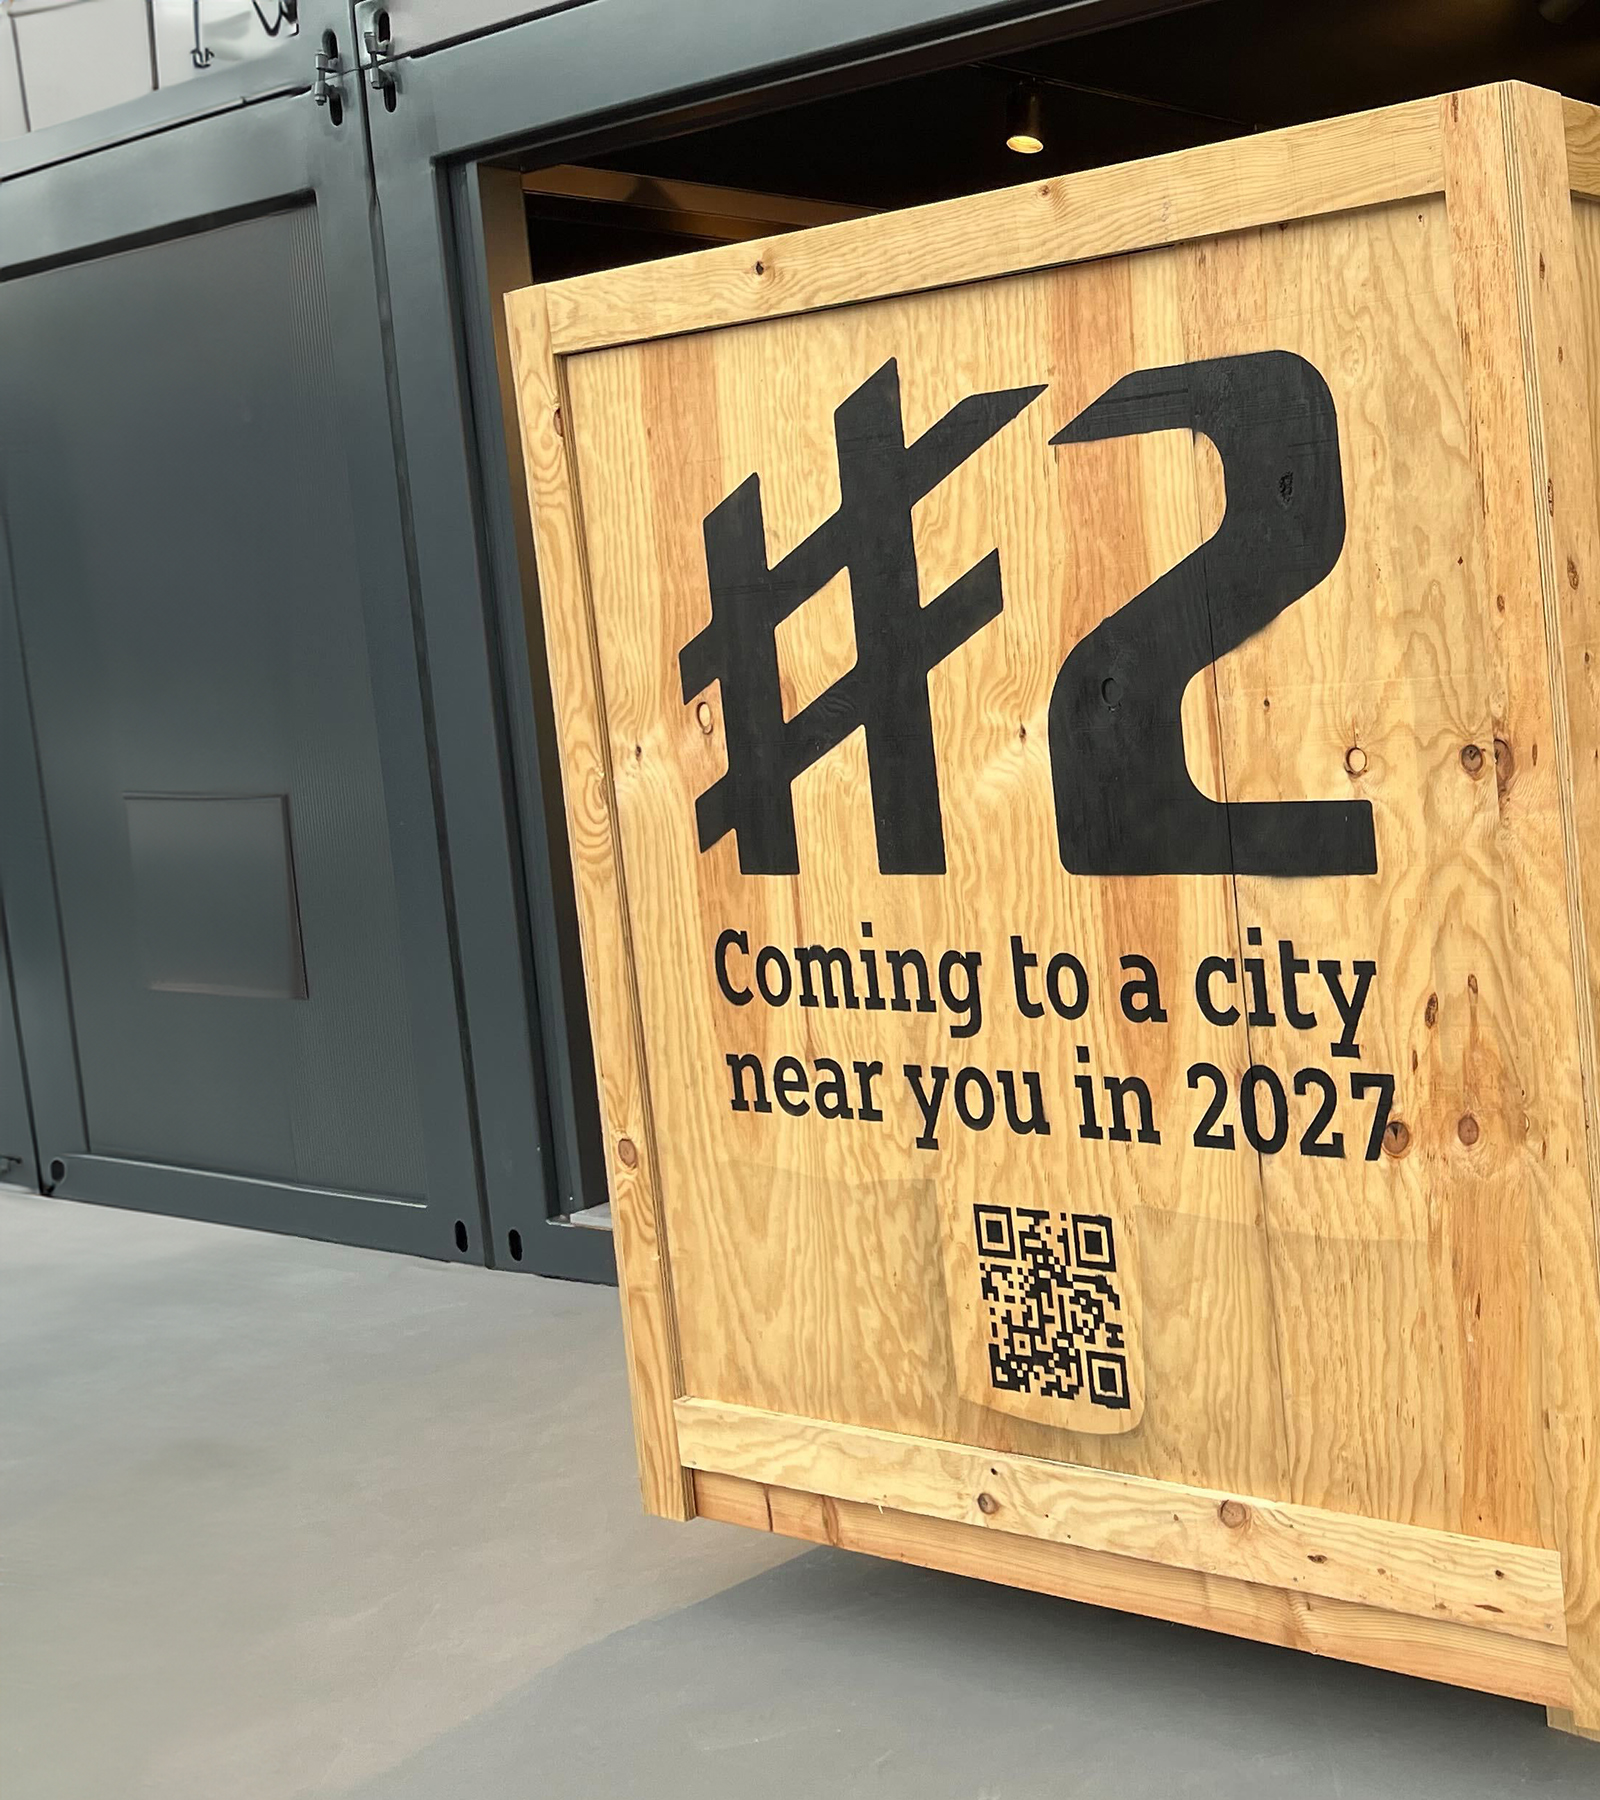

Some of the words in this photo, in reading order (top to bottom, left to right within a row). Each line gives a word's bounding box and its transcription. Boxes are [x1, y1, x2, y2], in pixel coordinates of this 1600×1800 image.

[678, 349, 1379, 877] #2
[714, 921, 982, 1039] Coming
[1010, 934, 1090, 1021] to
[1119, 953, 1168, 1024] a
[1194, 926, 1378, 1059] city
[725, 1049, 883, 1123] near
[903, 1058, 1051, 1149] you
[1074, 1045, 1163, 1147] in
[1185, 1061, 1398, 1162] 2027
